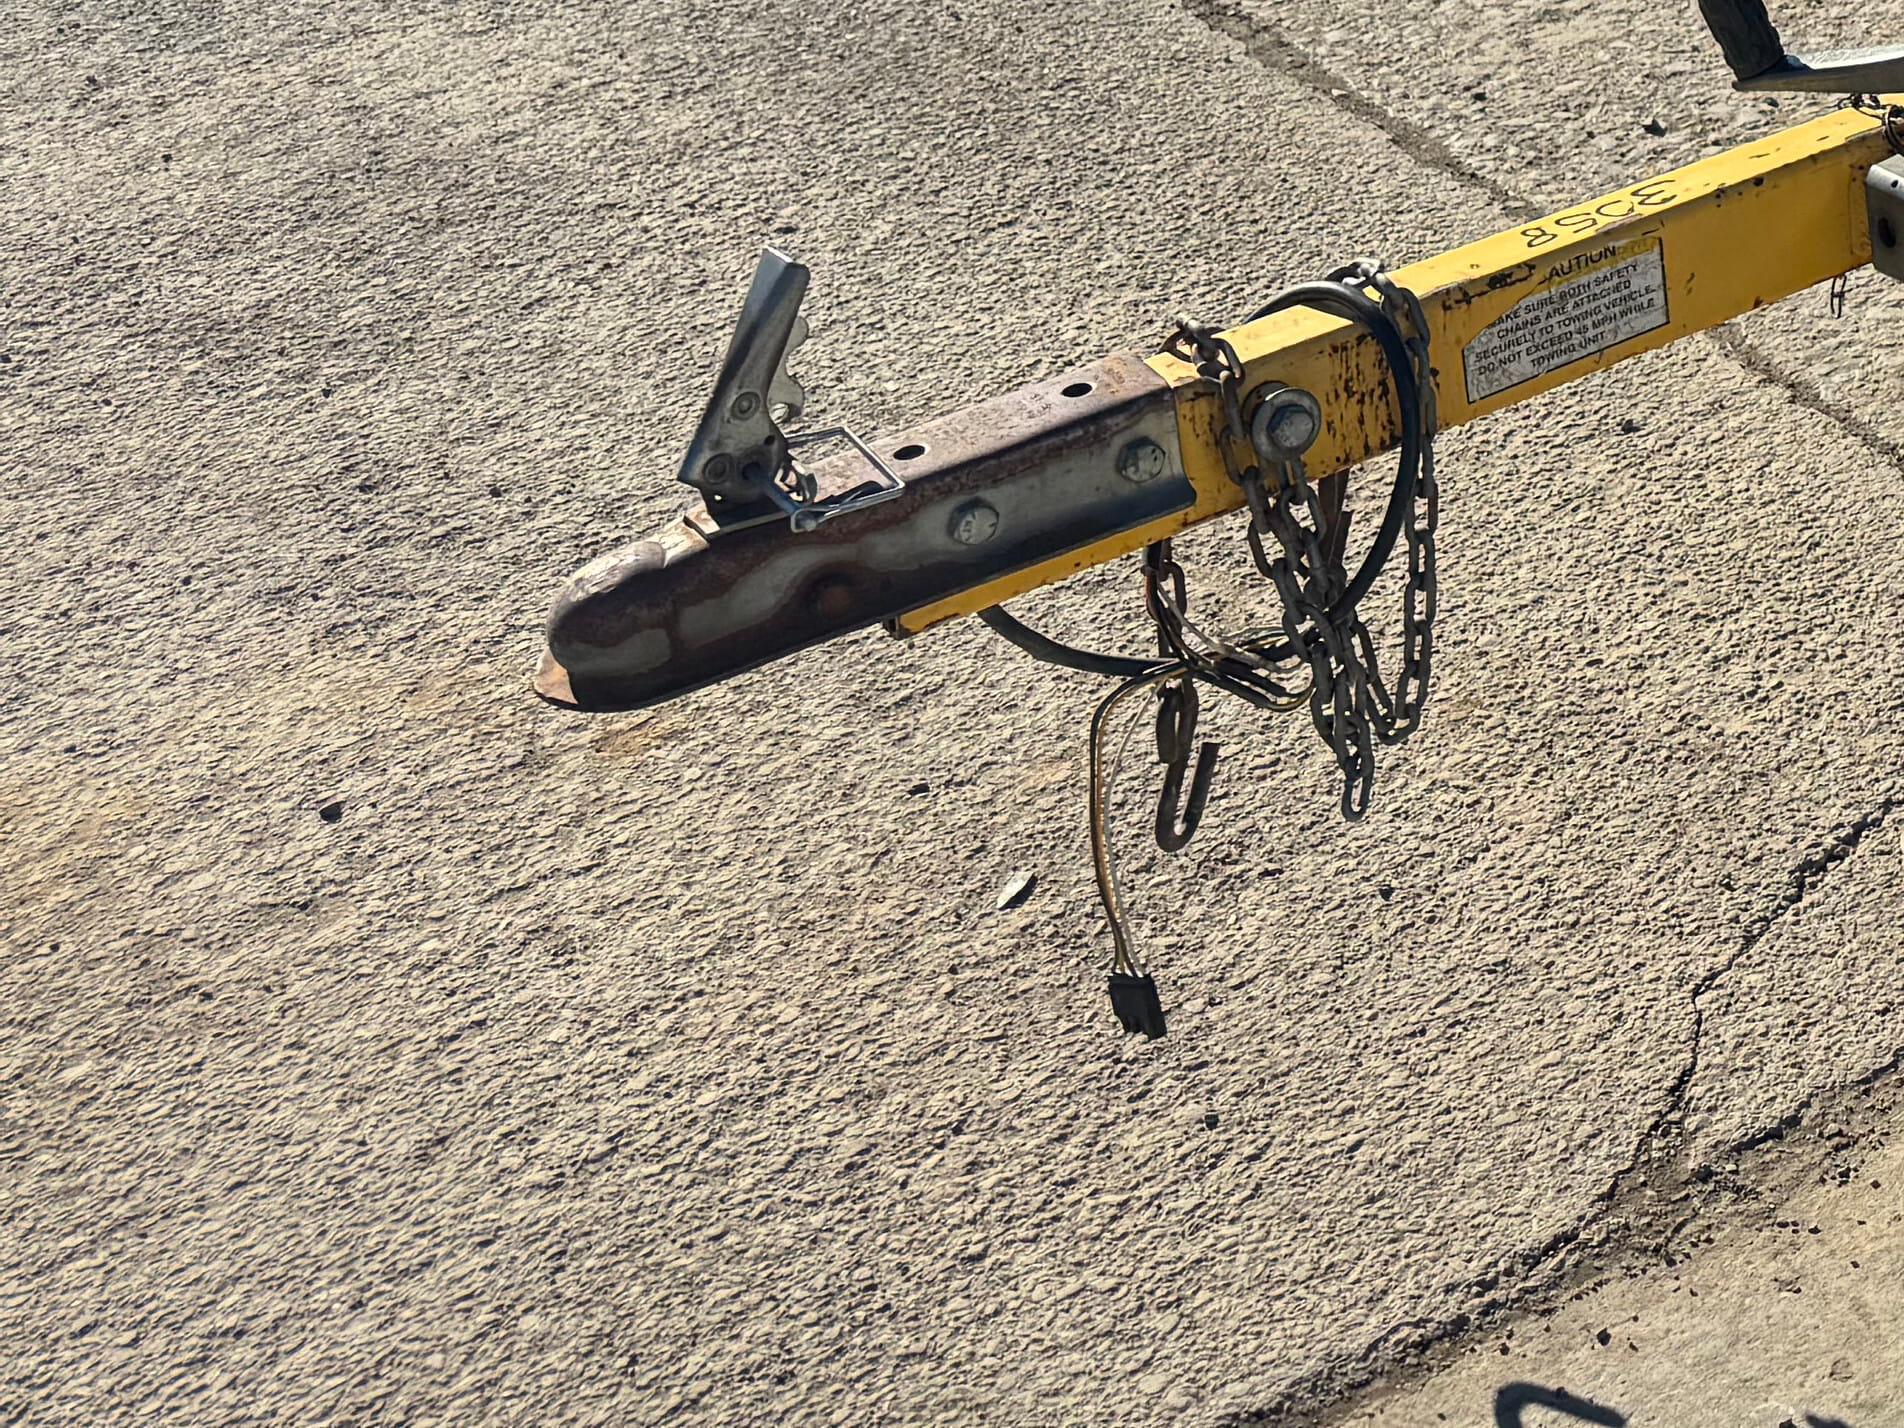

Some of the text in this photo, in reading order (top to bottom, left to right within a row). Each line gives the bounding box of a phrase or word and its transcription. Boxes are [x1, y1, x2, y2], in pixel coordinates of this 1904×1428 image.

[1547, 245, 1617, 280] AUTION
[1492, 260, 1639, 326] AKE SURE BOTH SAFETY
[1496, 279, 1632, 339] CHAINS ARE ATTACHED
[1475, 329, 1536, 363] SECURELY
[1538, 324, 1554, 337] TO
[1556, 304, 1602, 329] TOWING
[1478, 361, 1496, 376] DO
[1498, 349, 1523, 368] NOT
[1525, 330, 1573, 357] EXCEED
[1591, 312, 1617, 330] MPH
[1618, 297, 1655, 320] WHILE
[1530, 343, 1577, 367] TOWING
